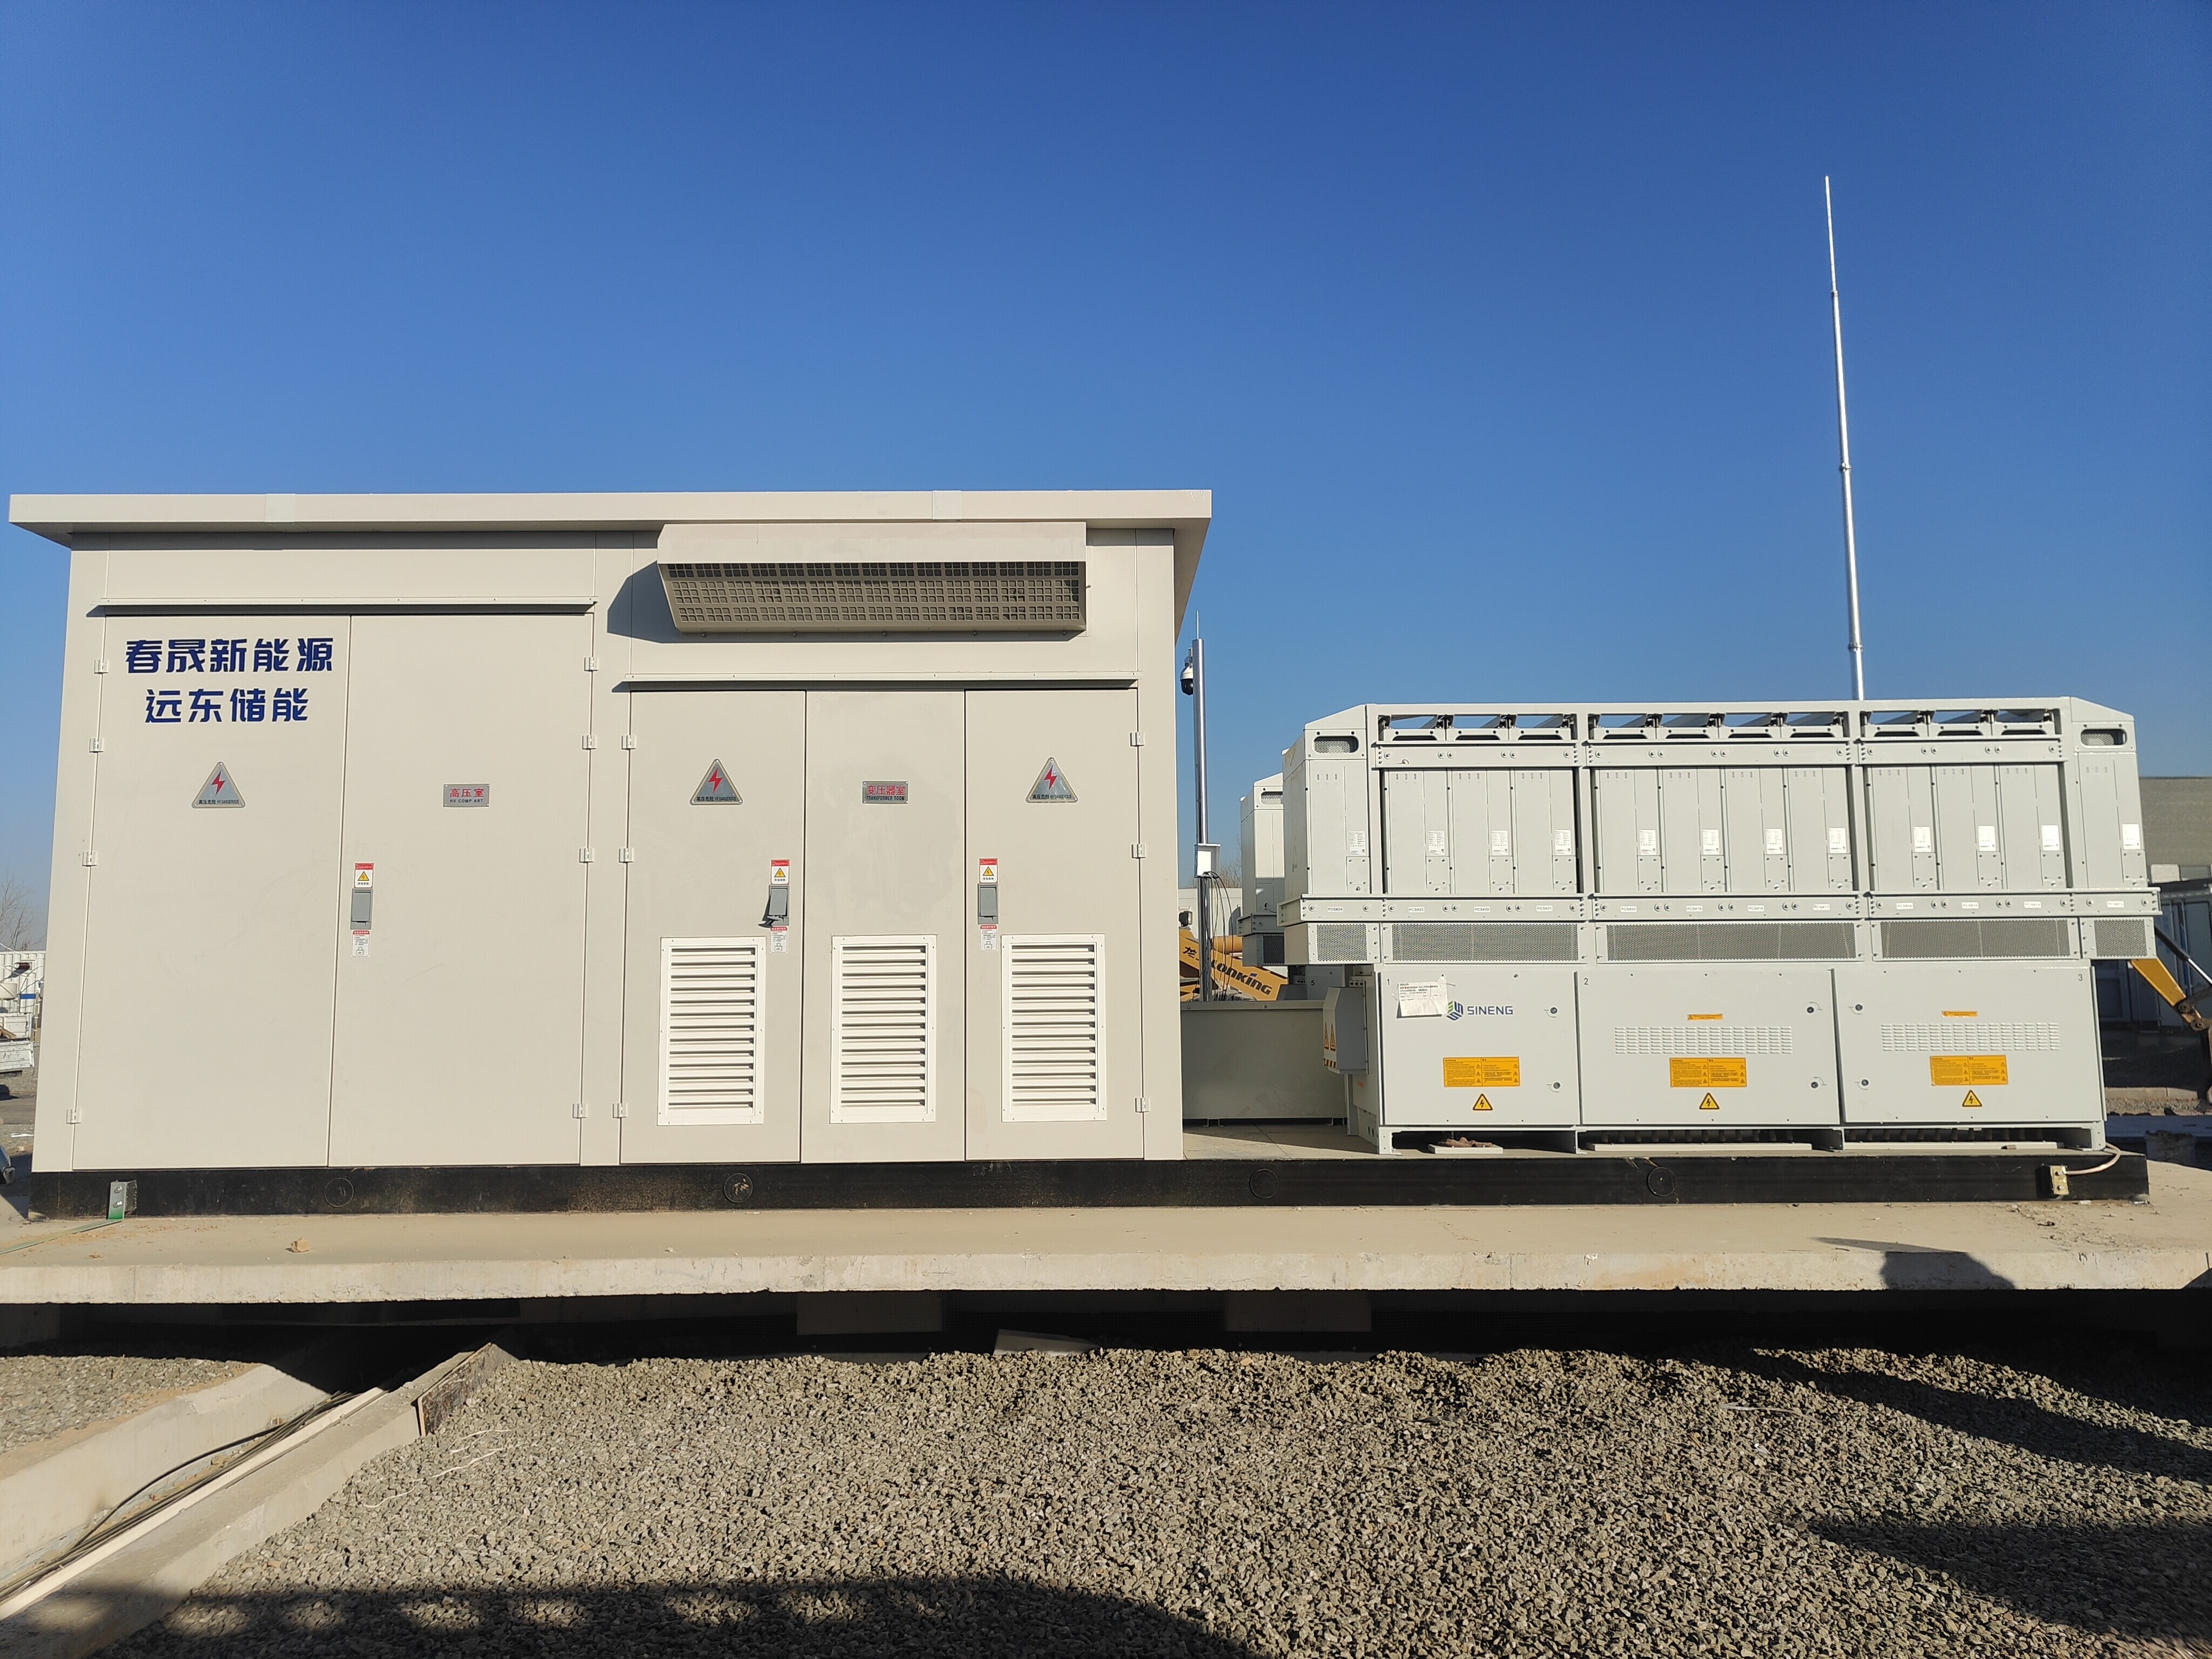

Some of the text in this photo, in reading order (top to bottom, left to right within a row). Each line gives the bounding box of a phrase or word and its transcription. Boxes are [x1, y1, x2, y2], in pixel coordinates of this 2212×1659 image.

[125, 637, 334, 674] 春晟新能源
[144, 687, 309, 723] 远东储能
[449, 788, 484, 798] 高压室
[866, 785, 905, 795] 变压器室
[2078, 973, 2083, 981] 3
[1467, 1006, 1513, 1015] SINENG
